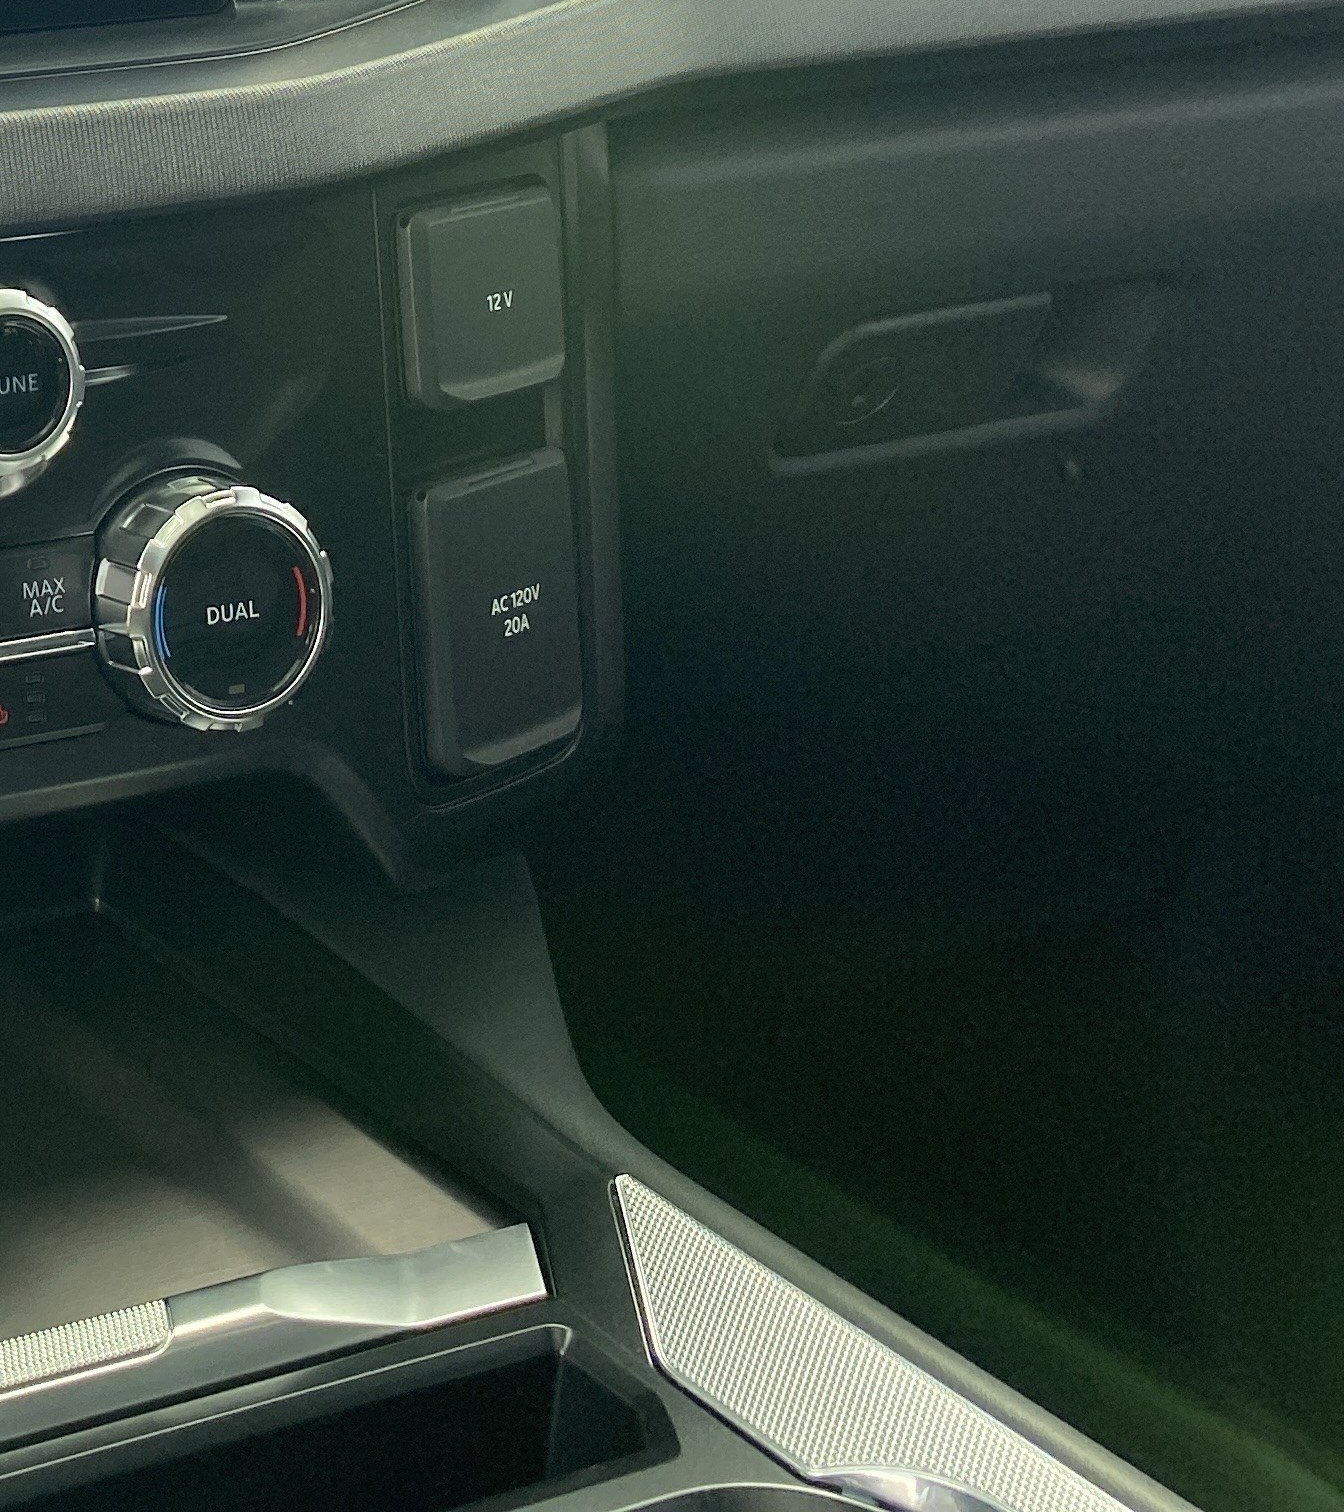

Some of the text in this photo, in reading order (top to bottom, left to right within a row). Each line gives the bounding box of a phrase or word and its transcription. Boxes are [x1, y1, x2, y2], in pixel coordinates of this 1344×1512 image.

[23, 577, 65, 600] MAX
[491, 583, 540, 616] AC 120V
[29, 595, 65, 617] A/C
[206, 599, 260, 625] DUAL
[504, 613, 530, 637] 20A
